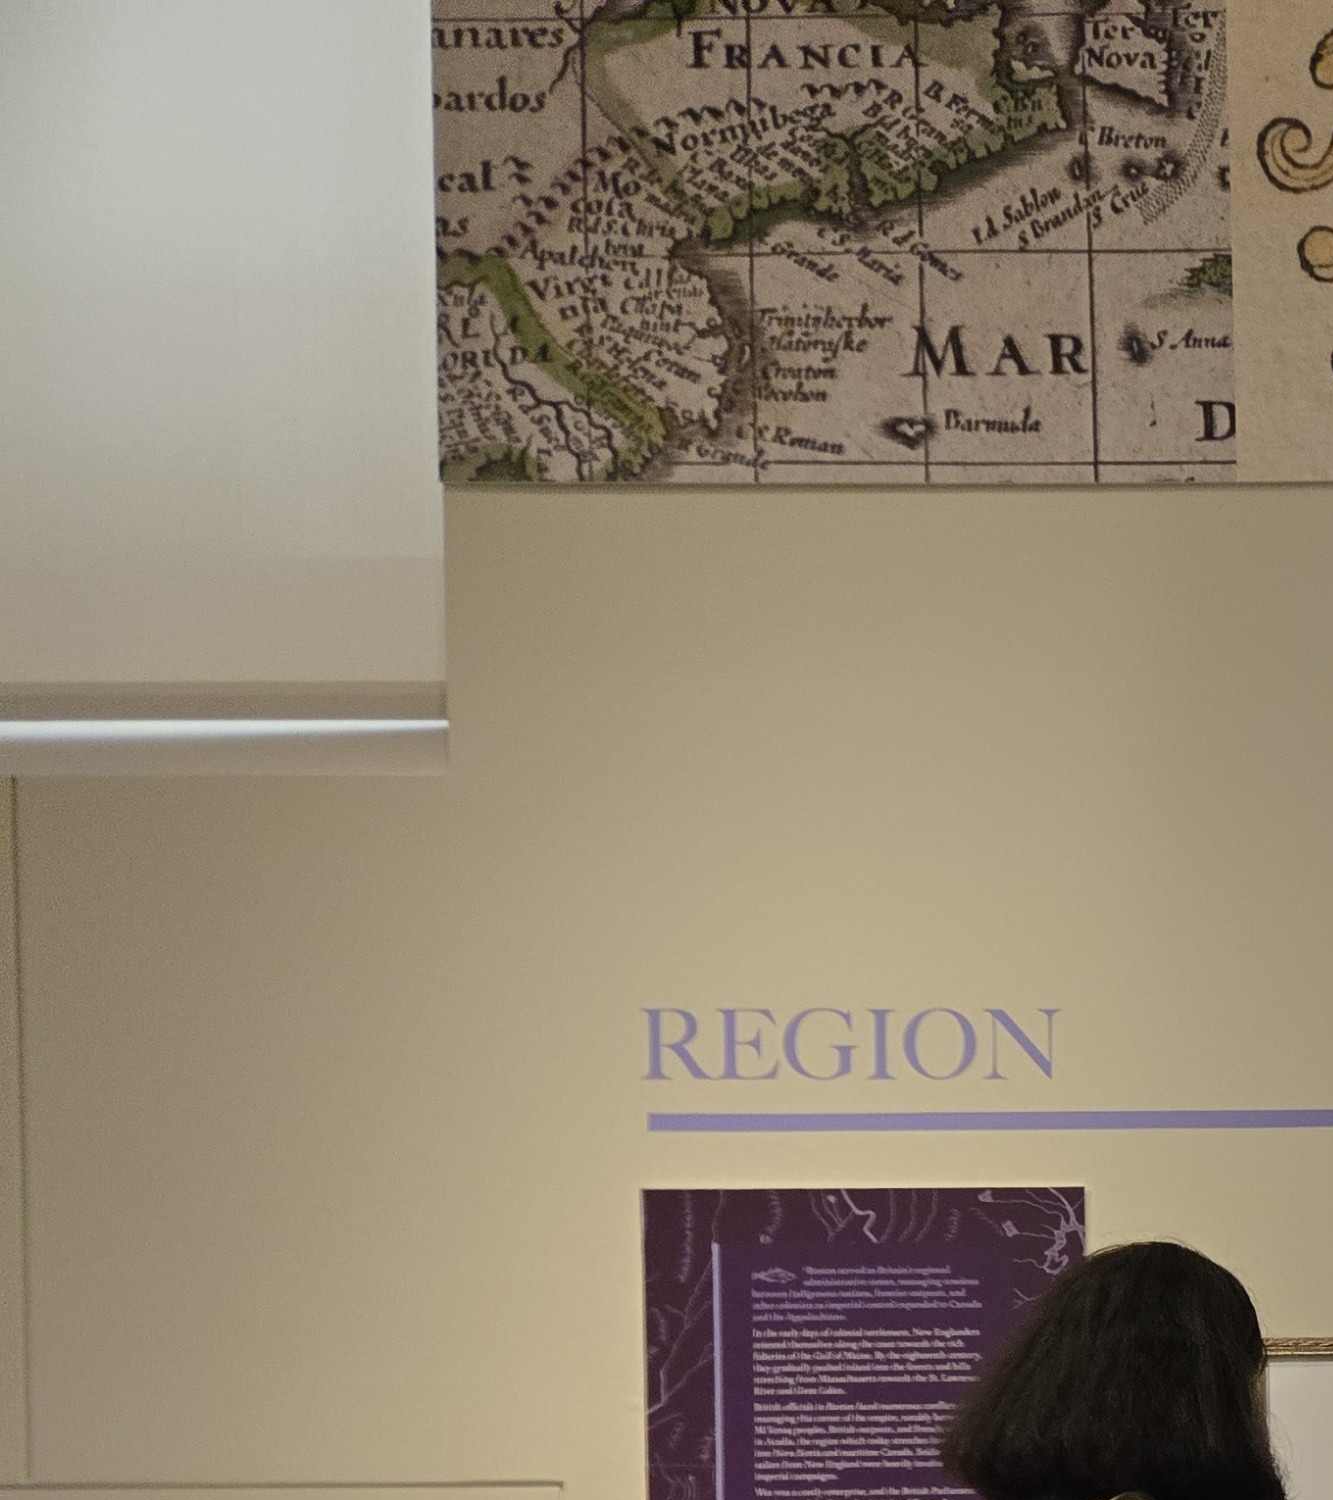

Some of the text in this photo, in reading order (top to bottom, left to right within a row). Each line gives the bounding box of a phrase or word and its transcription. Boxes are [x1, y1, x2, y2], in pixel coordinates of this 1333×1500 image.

[687, 28, 928, 70] FRANCIA
[1086, 46, 1158, 71] Nova
[433, 75, 546, 113] ardos
[900, 323, 1090, 378] MAR
[640, 1007, 1063, 1082] REGION
